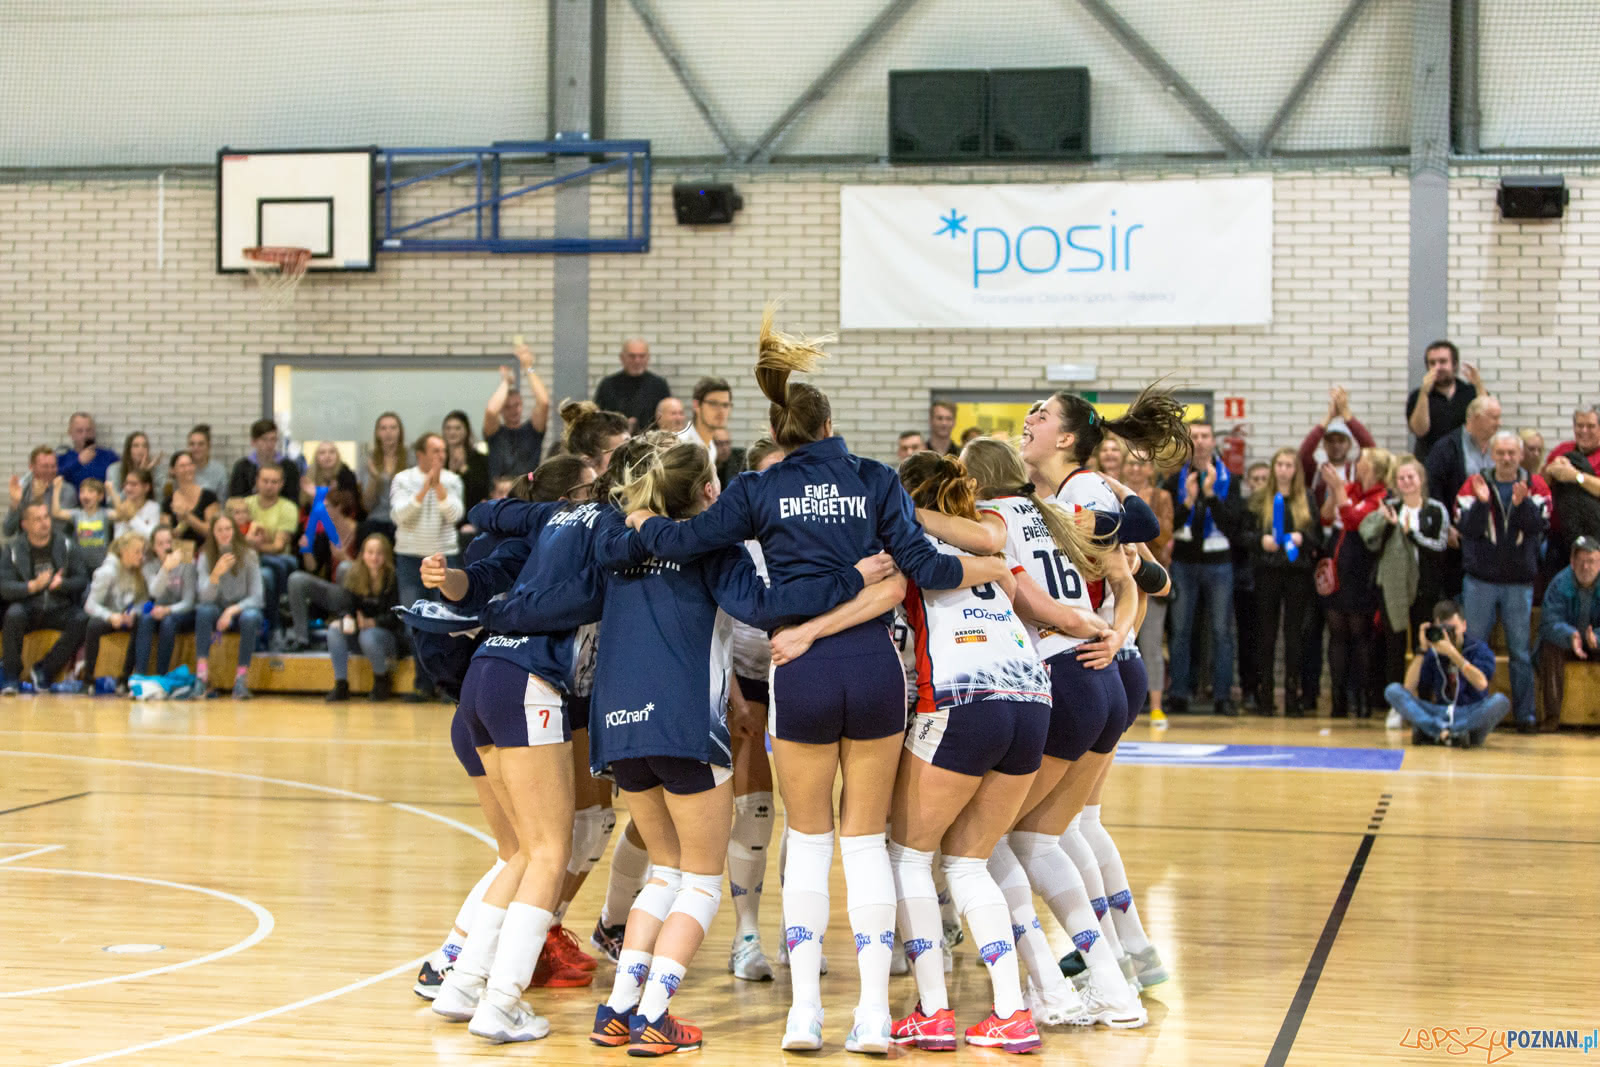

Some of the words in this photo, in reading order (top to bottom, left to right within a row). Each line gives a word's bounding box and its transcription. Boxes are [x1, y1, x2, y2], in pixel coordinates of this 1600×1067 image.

[973, 209, 1144, 289] posir
[804, 483, 839, 499] ENEA
[779, 496, 867, 519] ENERGETYK
[1032, 549, 1082, 600] 16
[539, 709, 550, 729] 7
